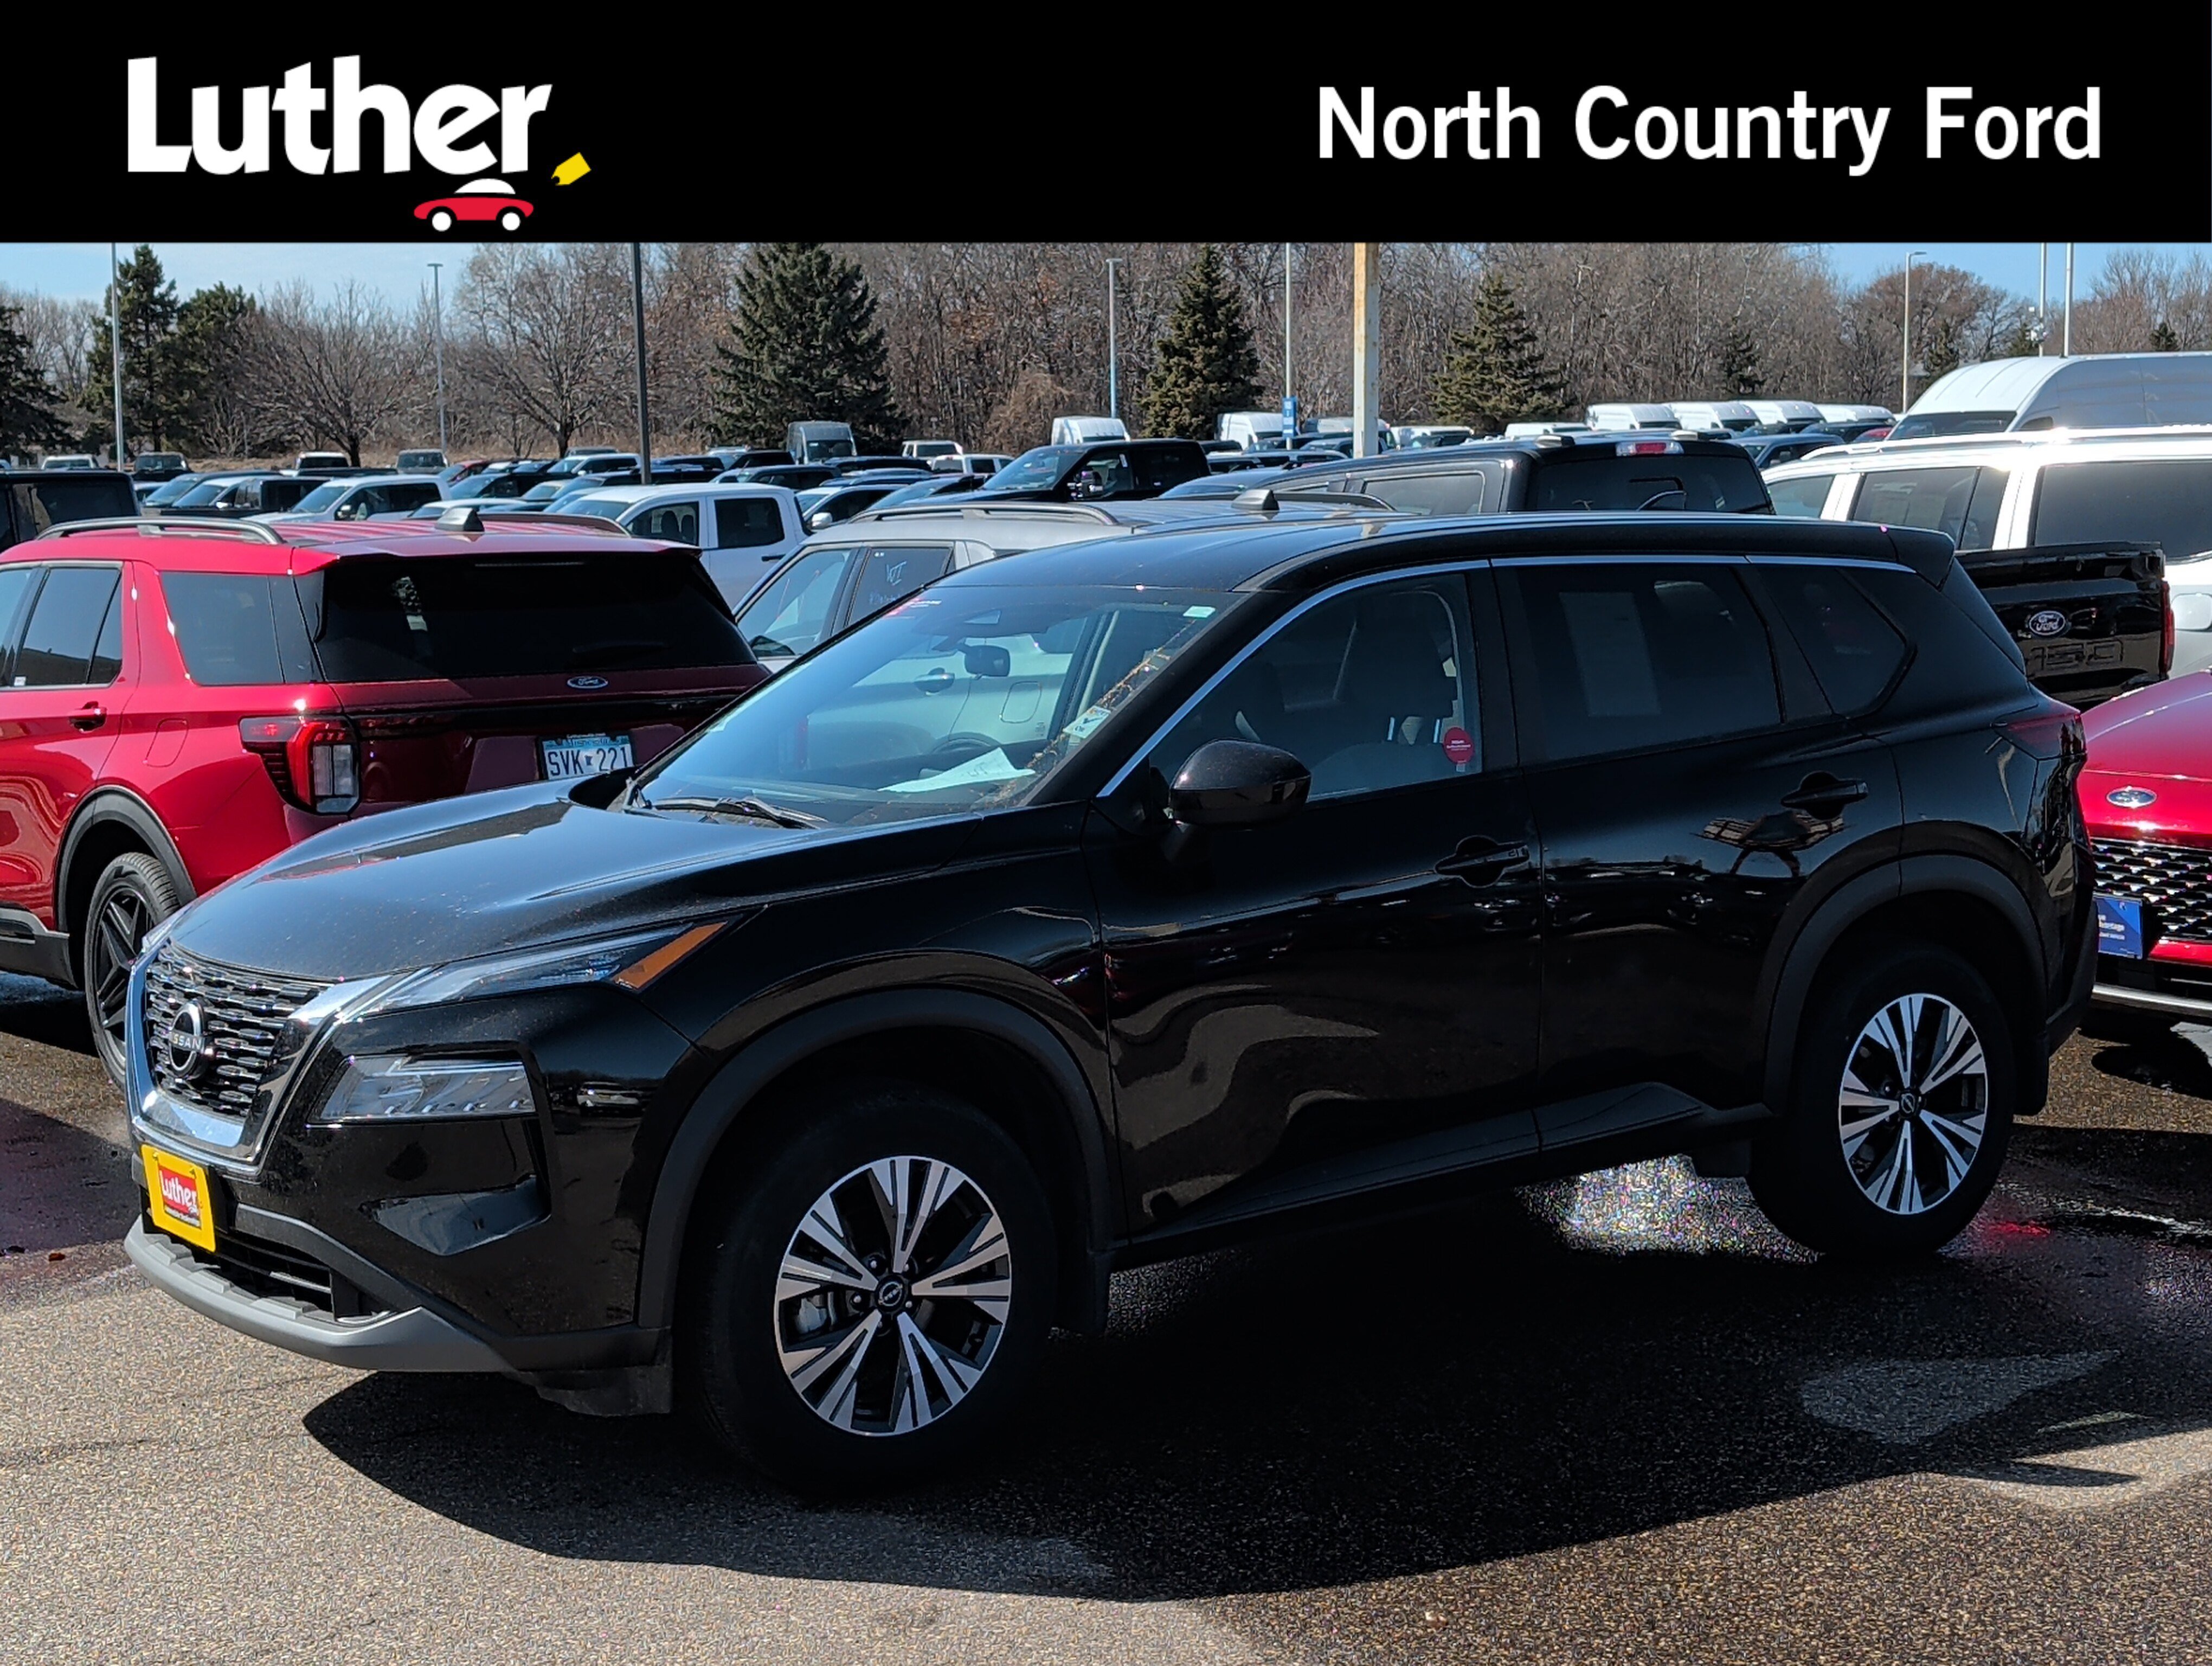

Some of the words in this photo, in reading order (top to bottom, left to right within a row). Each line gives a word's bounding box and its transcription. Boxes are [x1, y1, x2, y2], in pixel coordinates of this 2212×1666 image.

[2035, 614, 2059, 631] Ford
[548, 749, 584, 776] SVK
[596, 747, 628, 772] 221
[159, 1169, 197, 1207] Luther
